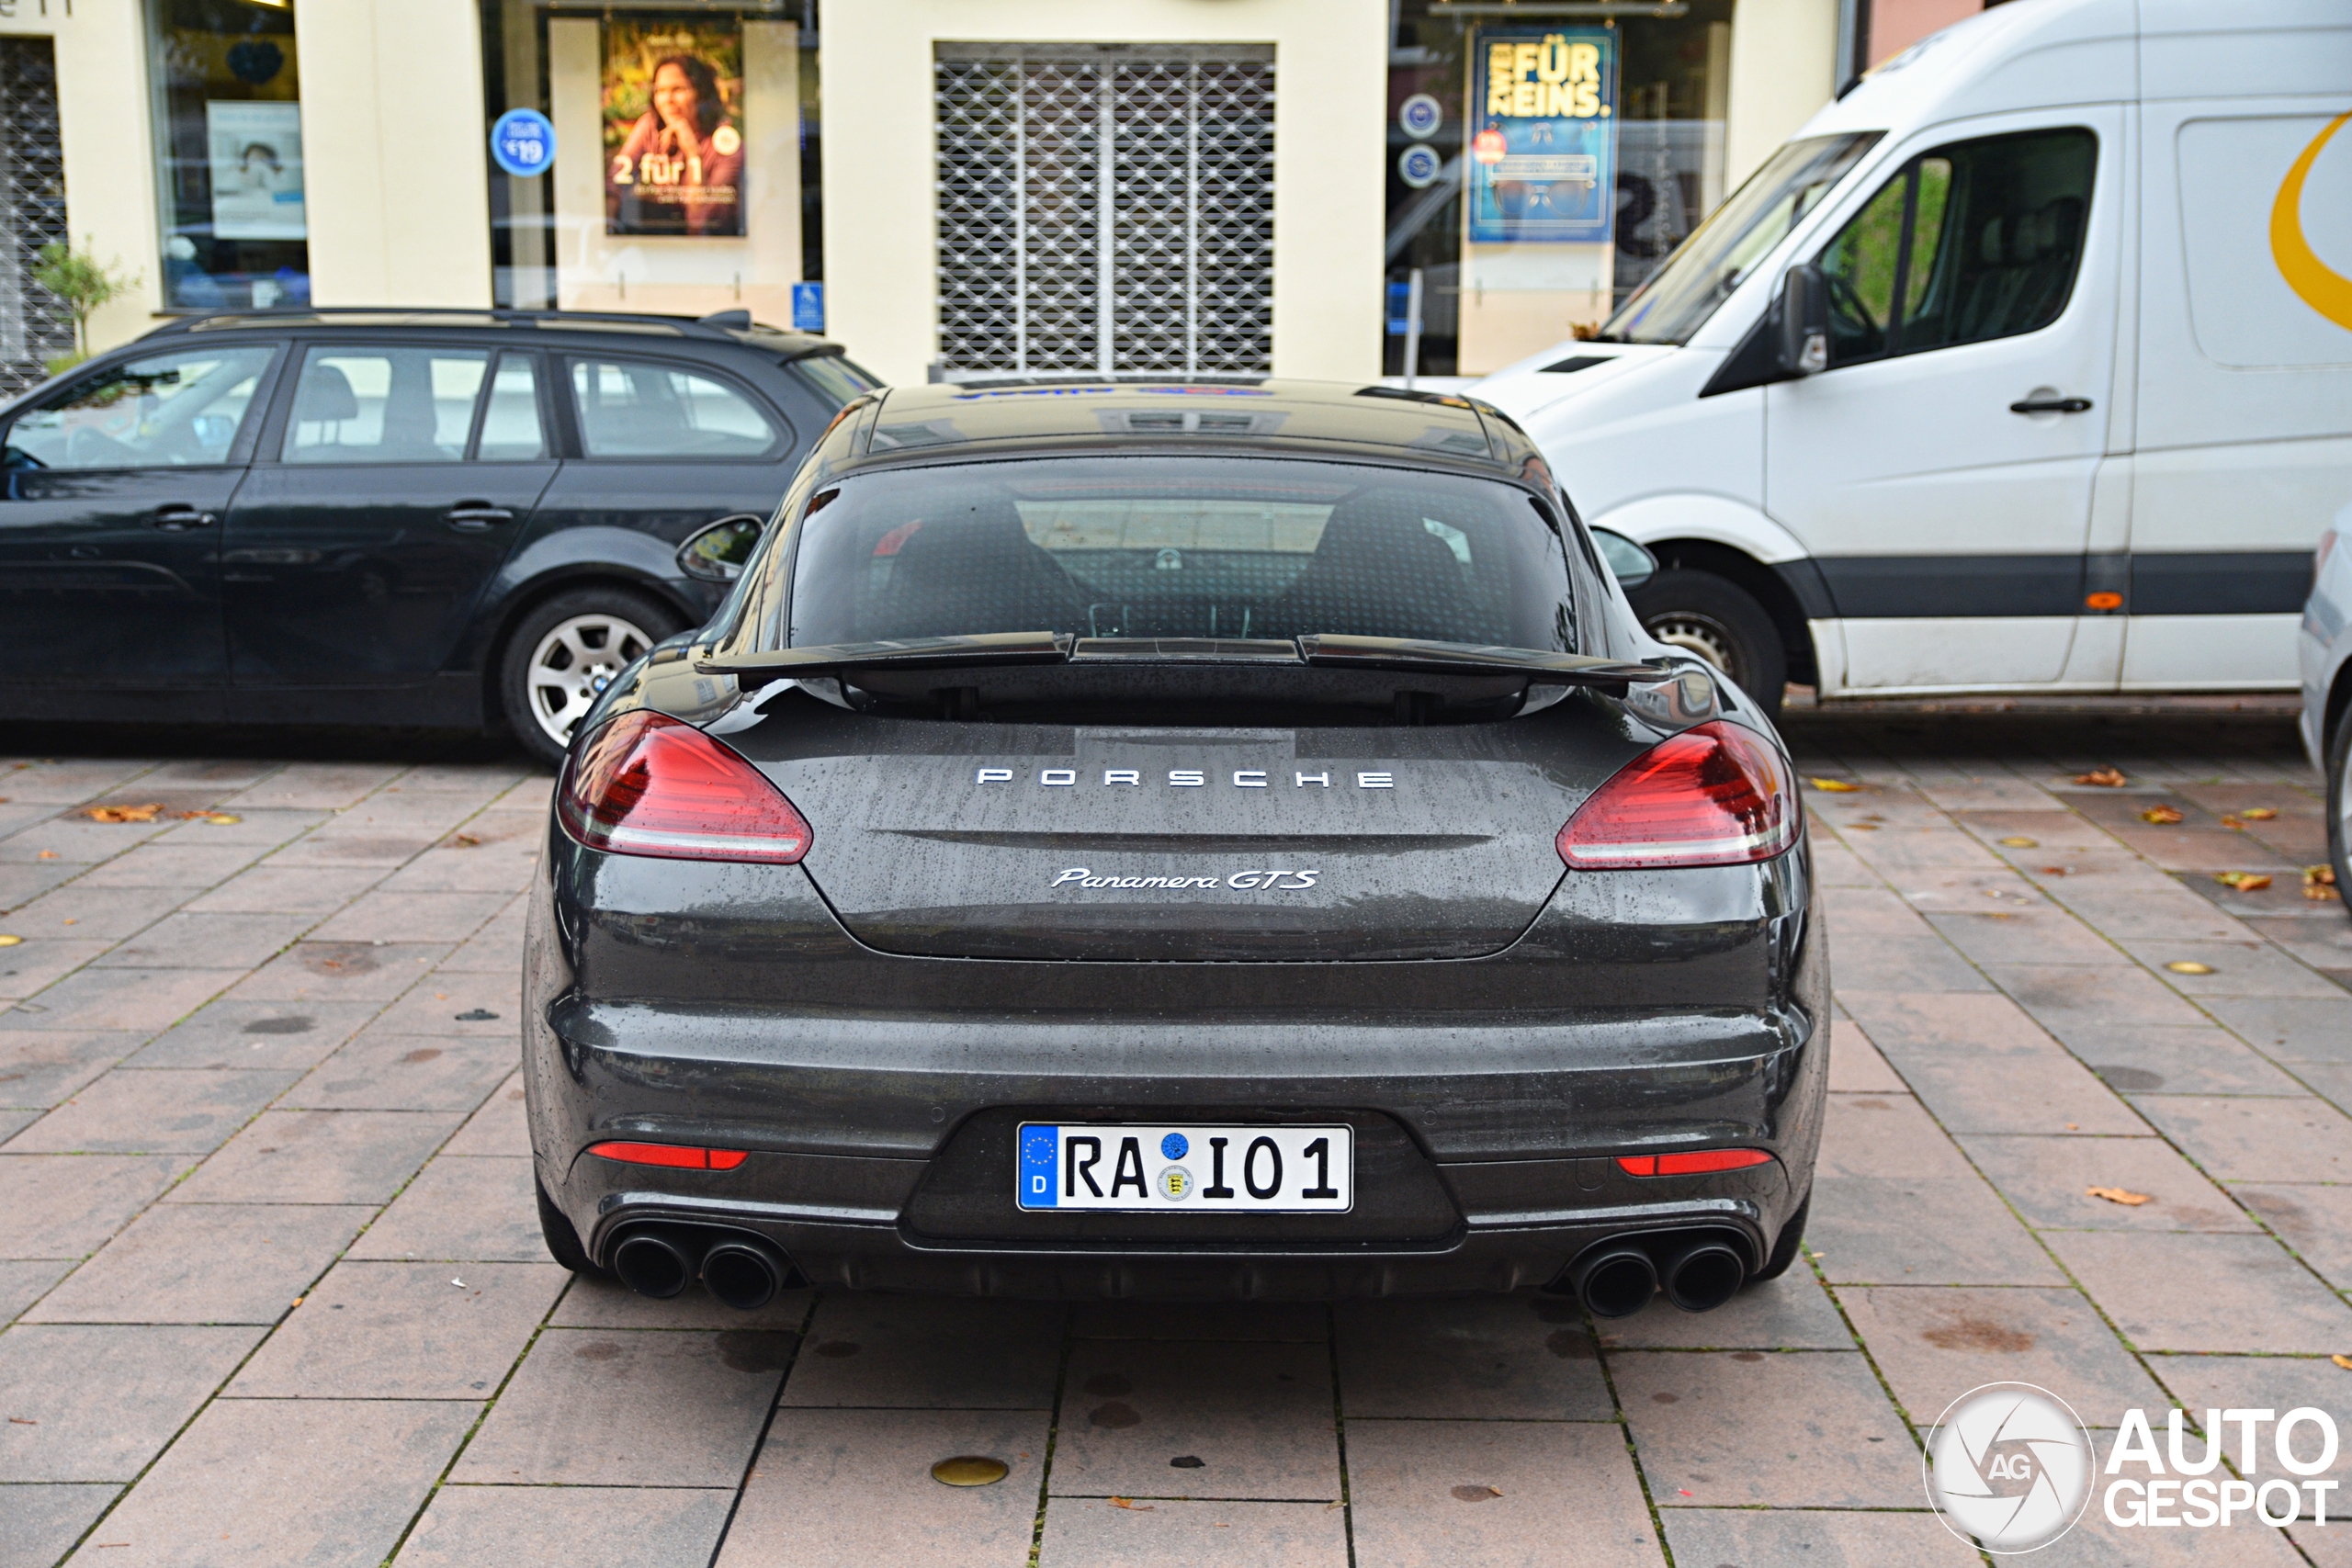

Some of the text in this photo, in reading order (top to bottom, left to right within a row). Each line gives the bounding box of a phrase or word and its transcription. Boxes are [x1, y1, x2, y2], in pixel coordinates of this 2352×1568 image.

[1514, 33, 1600, 83] FÜR
[1512, 81, 1611, 118] EINS.
[613, 152, 702, 186] 2 für 1
[978, 768, 1394, 789] PORSCHE
[1051, 868, 1319, 890] Panamera GTS
[1066, 1135, 1148, 1198] RA
[1032, 1175, 1047, 1194] D
